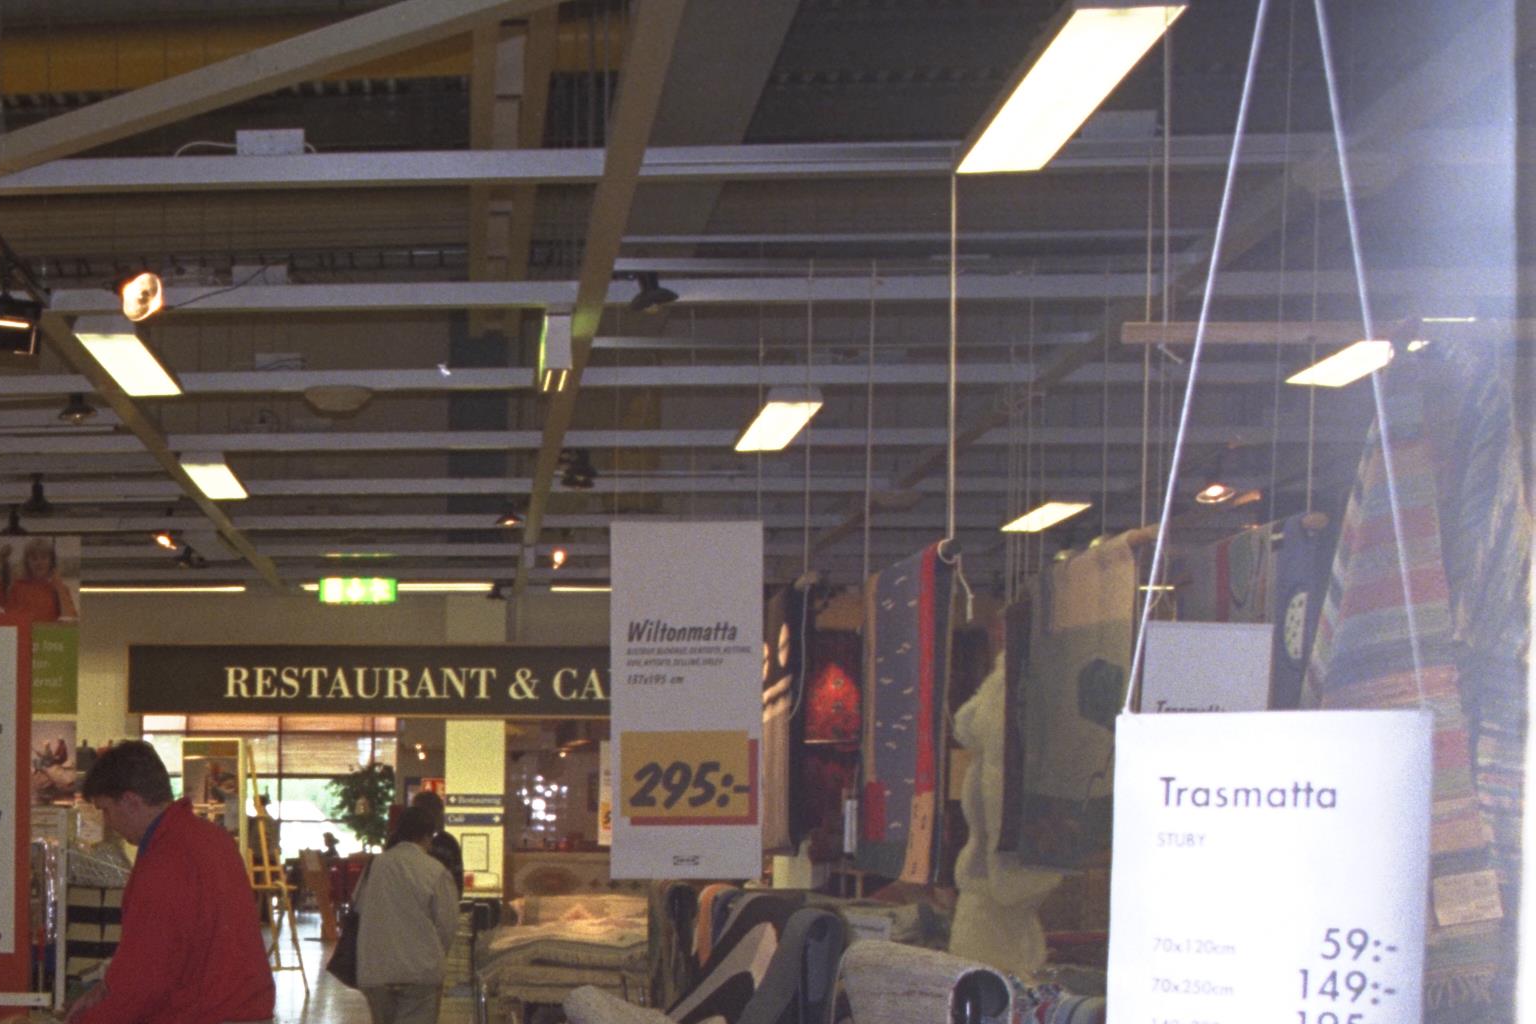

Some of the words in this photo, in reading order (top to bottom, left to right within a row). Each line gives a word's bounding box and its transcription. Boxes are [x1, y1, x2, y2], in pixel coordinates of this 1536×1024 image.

[627, 619, 737, 642] Wiltonmatta
[225, 667, 496, 699] RESTAURANT
[508, 667, 539, 700] &
[552, 667, 610, 700] CA
[628, 760, 752, 810] 295:-
[1159, 776, 1337, 809] Trasmatta
[1156, 831, 1206, 848] STUBY
[1320, 928, 1398, 963] 59:-
[1298, 968, 1397, 1006] 149:-
